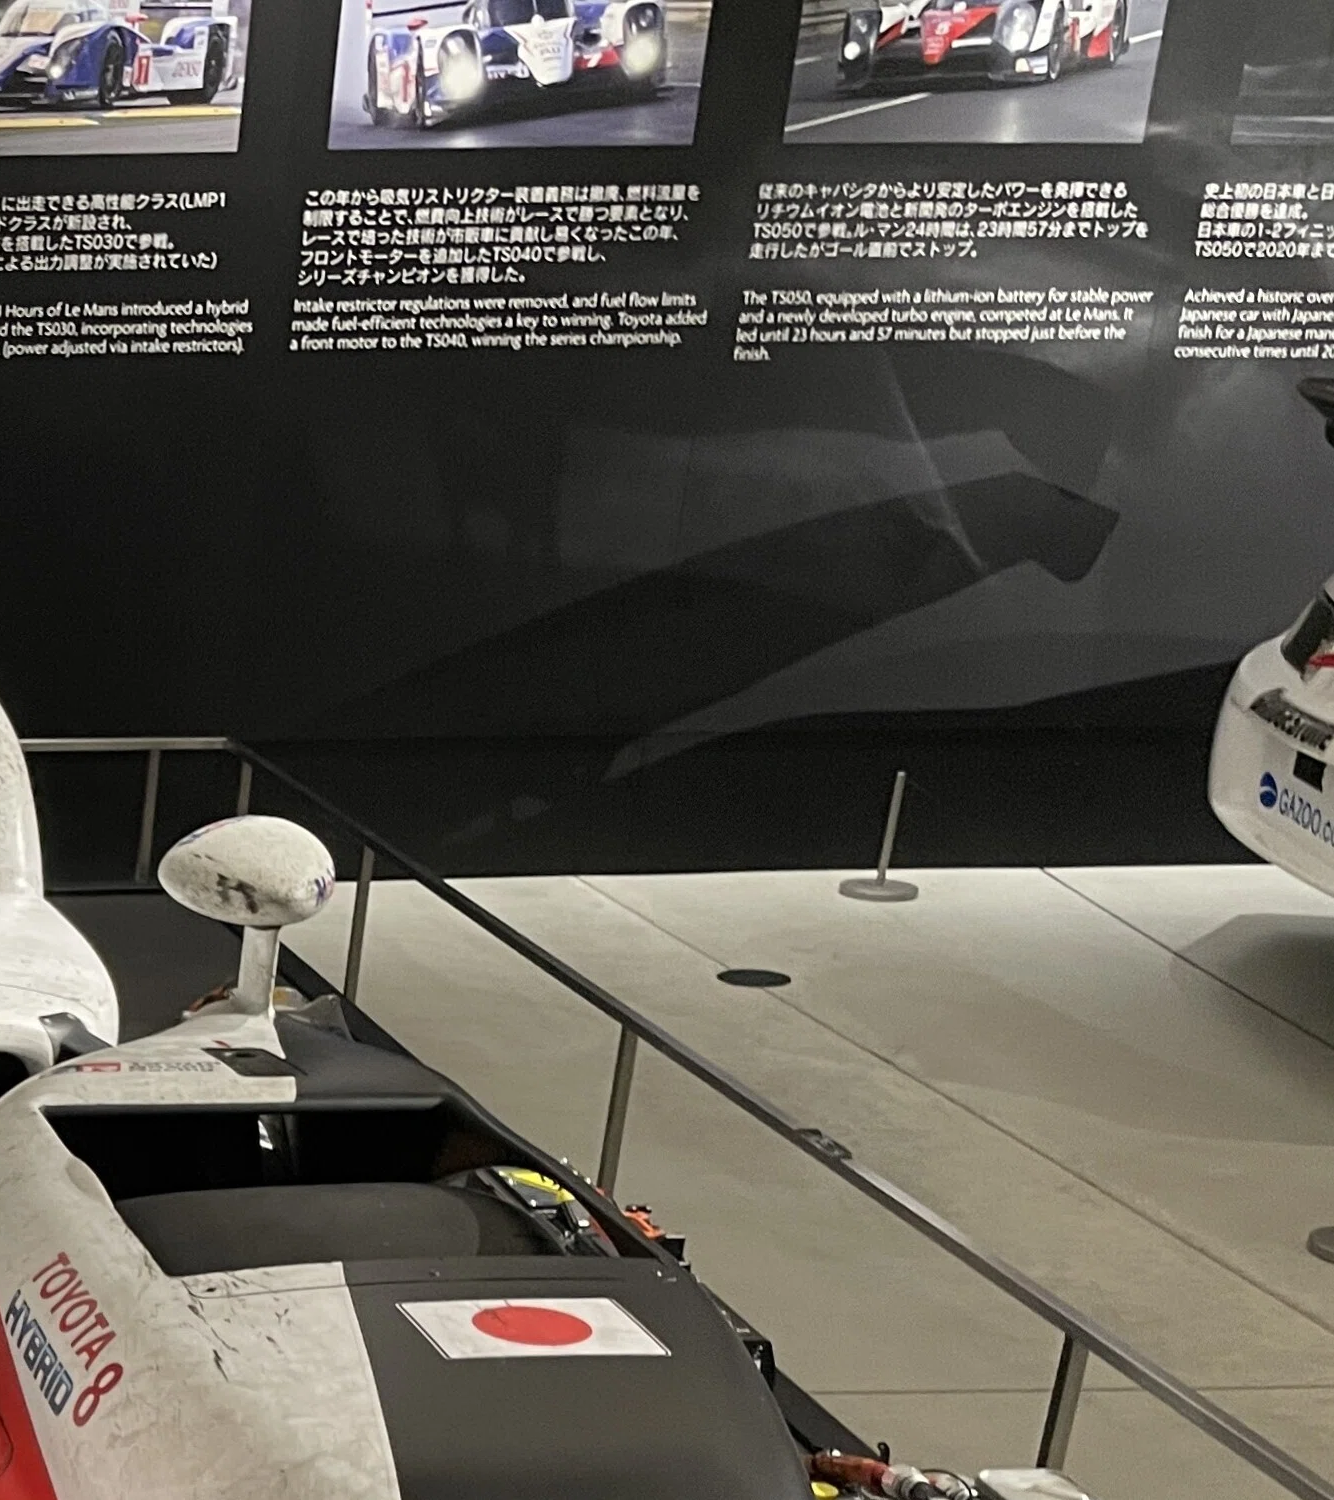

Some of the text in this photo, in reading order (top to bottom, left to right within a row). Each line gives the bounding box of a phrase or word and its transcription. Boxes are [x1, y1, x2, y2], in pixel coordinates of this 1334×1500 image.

[5, 304, 44, 318] Hours
[46, 301, 63, 318] of
[64, 303, 81, 317] Le
[83, 303, 119, 317] Mans
[121, 300, 193, 316] introduced
[194, 303, 204, 316] a
[205, 298, 249, 319] hybrid
[11, 321, 34, 337] the
[80, 321, 168, 339] incorporating
[170, 318, 253, 337] technologies
[2, 340, 49, 359] (power
[50, 338, 107, 358] adjusted
[109, 340, 128, 354] via
[130, 337, 171, 353] intake
[289, 338, 299, 351] a
[300, 334, 335, 351] front
[336, 336, 379, 350] motor
[381, 336, 398, 349] to
[399, 332, 423, 349] the
[471, 333, 522, 351] winning
[524, 330, 548, 347] the
[550, 334, 587, 346] series
[32, 1251, 124, 1427] TOYOTA 8
[5, 1288, 74, 1416] HYBRID
